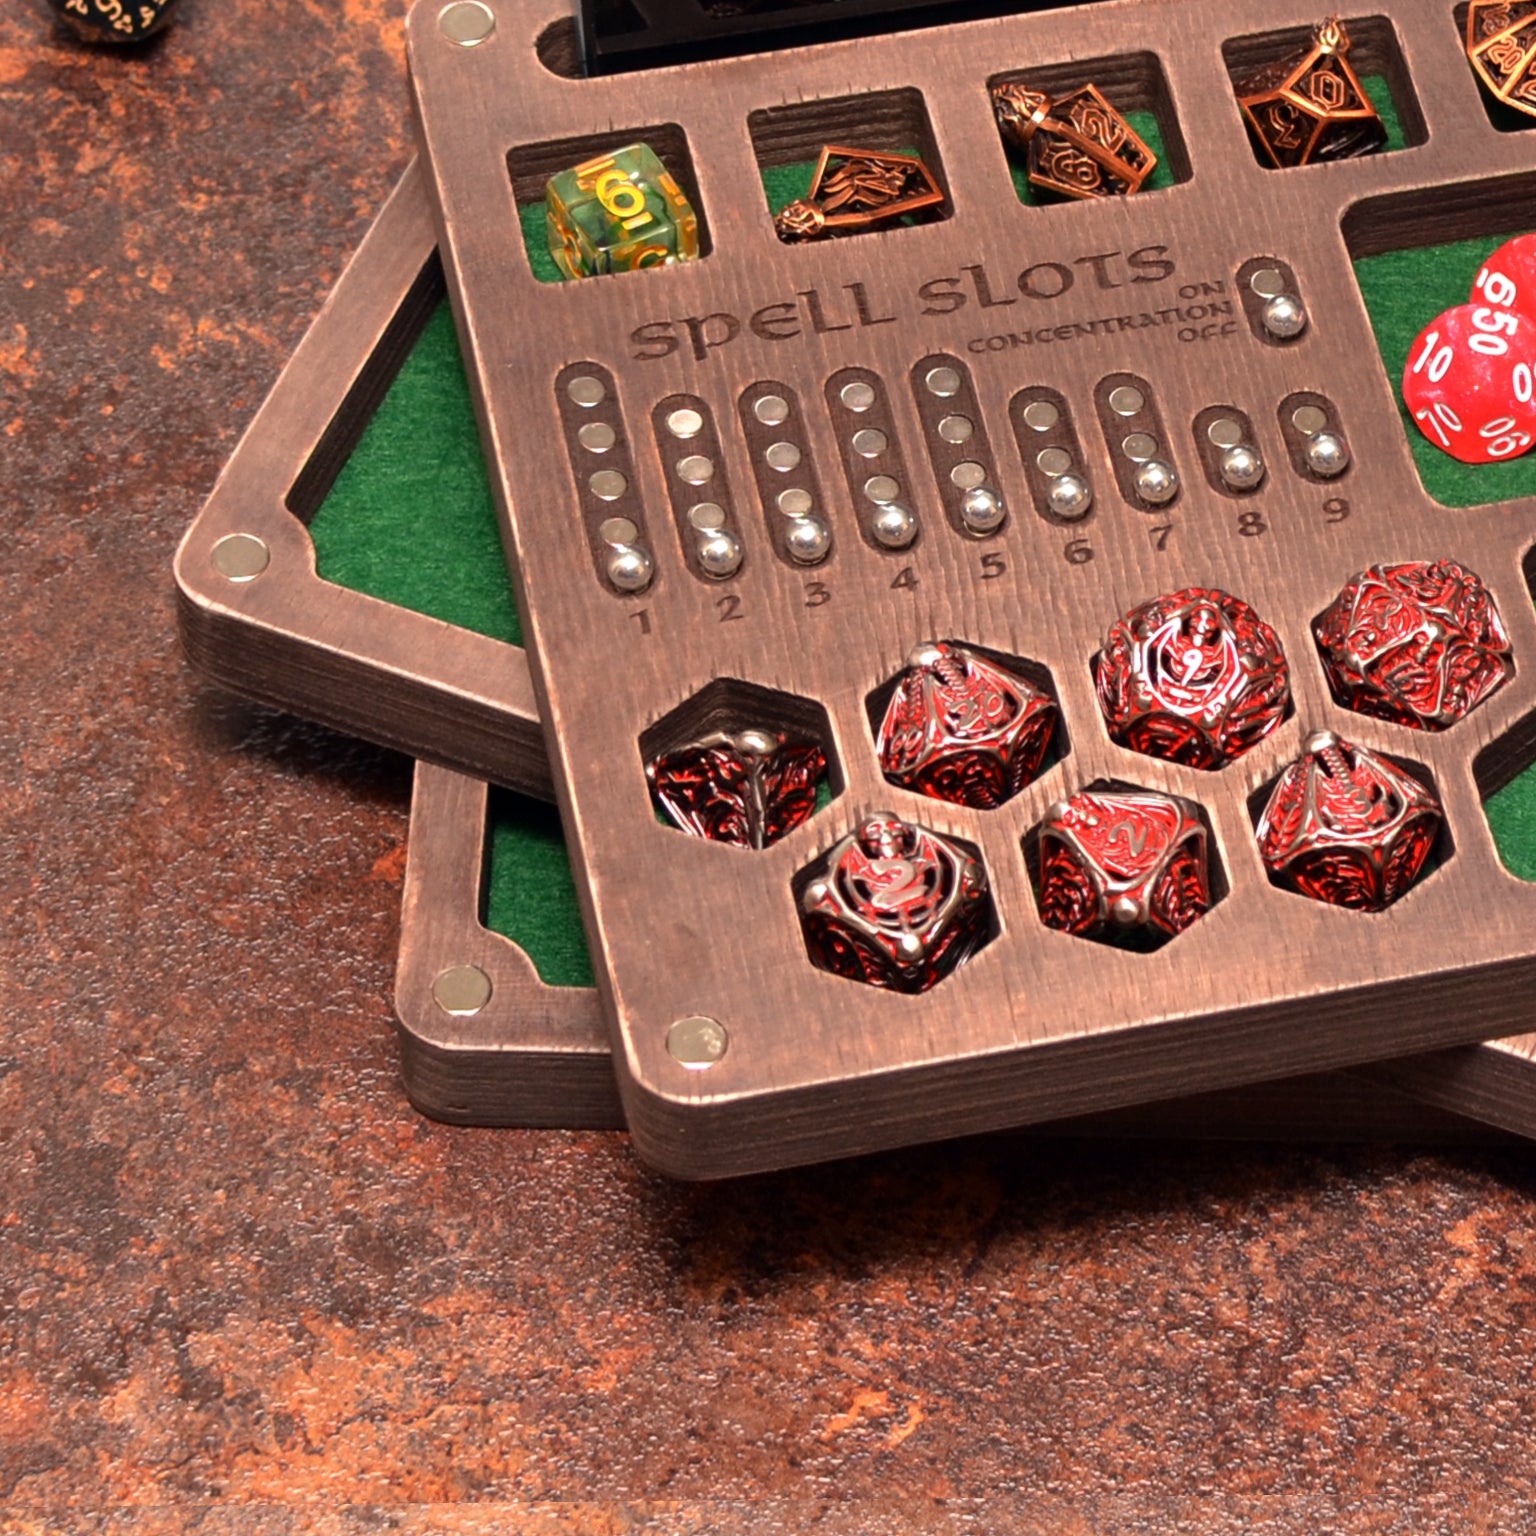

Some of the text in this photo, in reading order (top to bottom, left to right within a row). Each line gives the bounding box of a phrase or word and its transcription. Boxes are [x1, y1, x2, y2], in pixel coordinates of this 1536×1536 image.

[596, 169, 653, 230] 6
[630, 245, 1176, 361] SPELL SLOTS
[1178, 279, 1225, 300] ON
[967, 301, 1233, 354] CONCENTRATION
[1177, 320, 1238, 343] OFF
[1468, 308, 1519, 356] 50
[1413, 331, 1453, 383] 10
[629, 497, 1350, 635] 1 2 3 4 5 6 7 8 9
